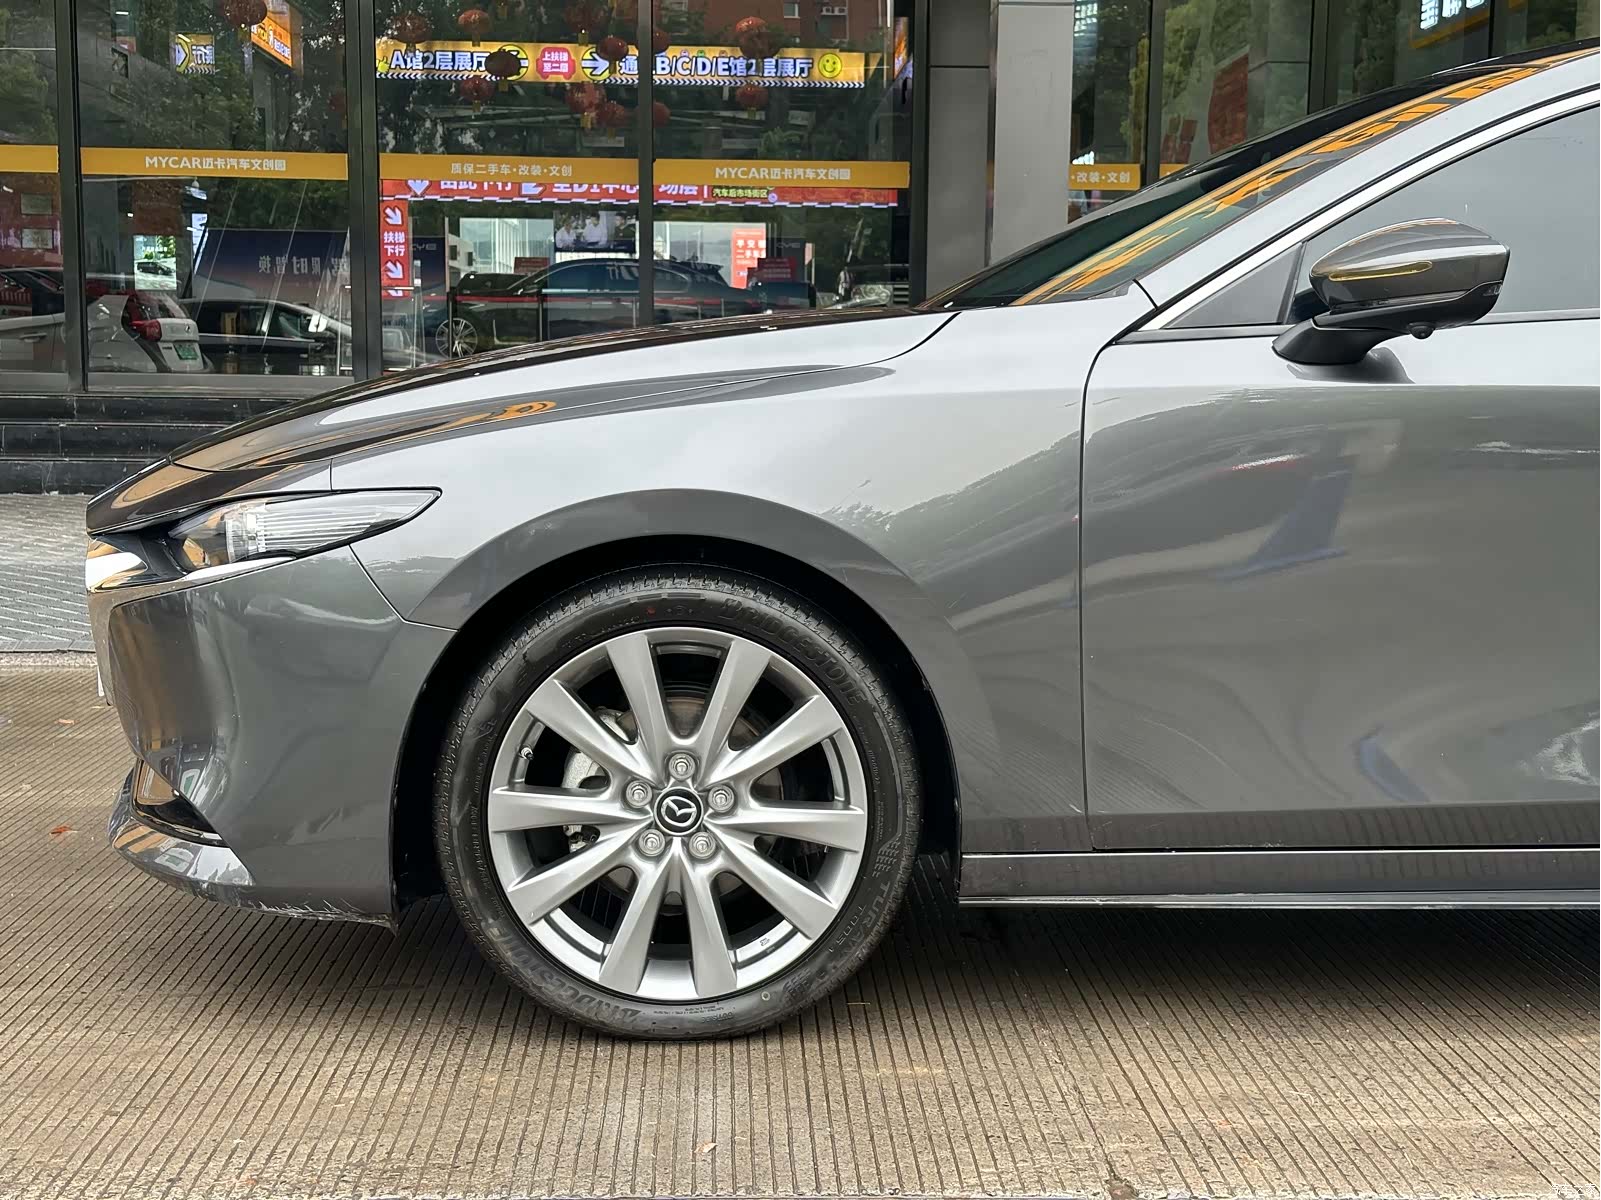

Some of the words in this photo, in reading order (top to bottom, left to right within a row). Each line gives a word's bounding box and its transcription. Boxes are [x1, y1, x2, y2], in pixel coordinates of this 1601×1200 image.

[542, 51, 568, 61] 上扶梯
[145, 155, 286, 171] MYCAR迈卡汽车文创园
[715, 166, 851, 181] MYCAR迈卡汽车文创园
